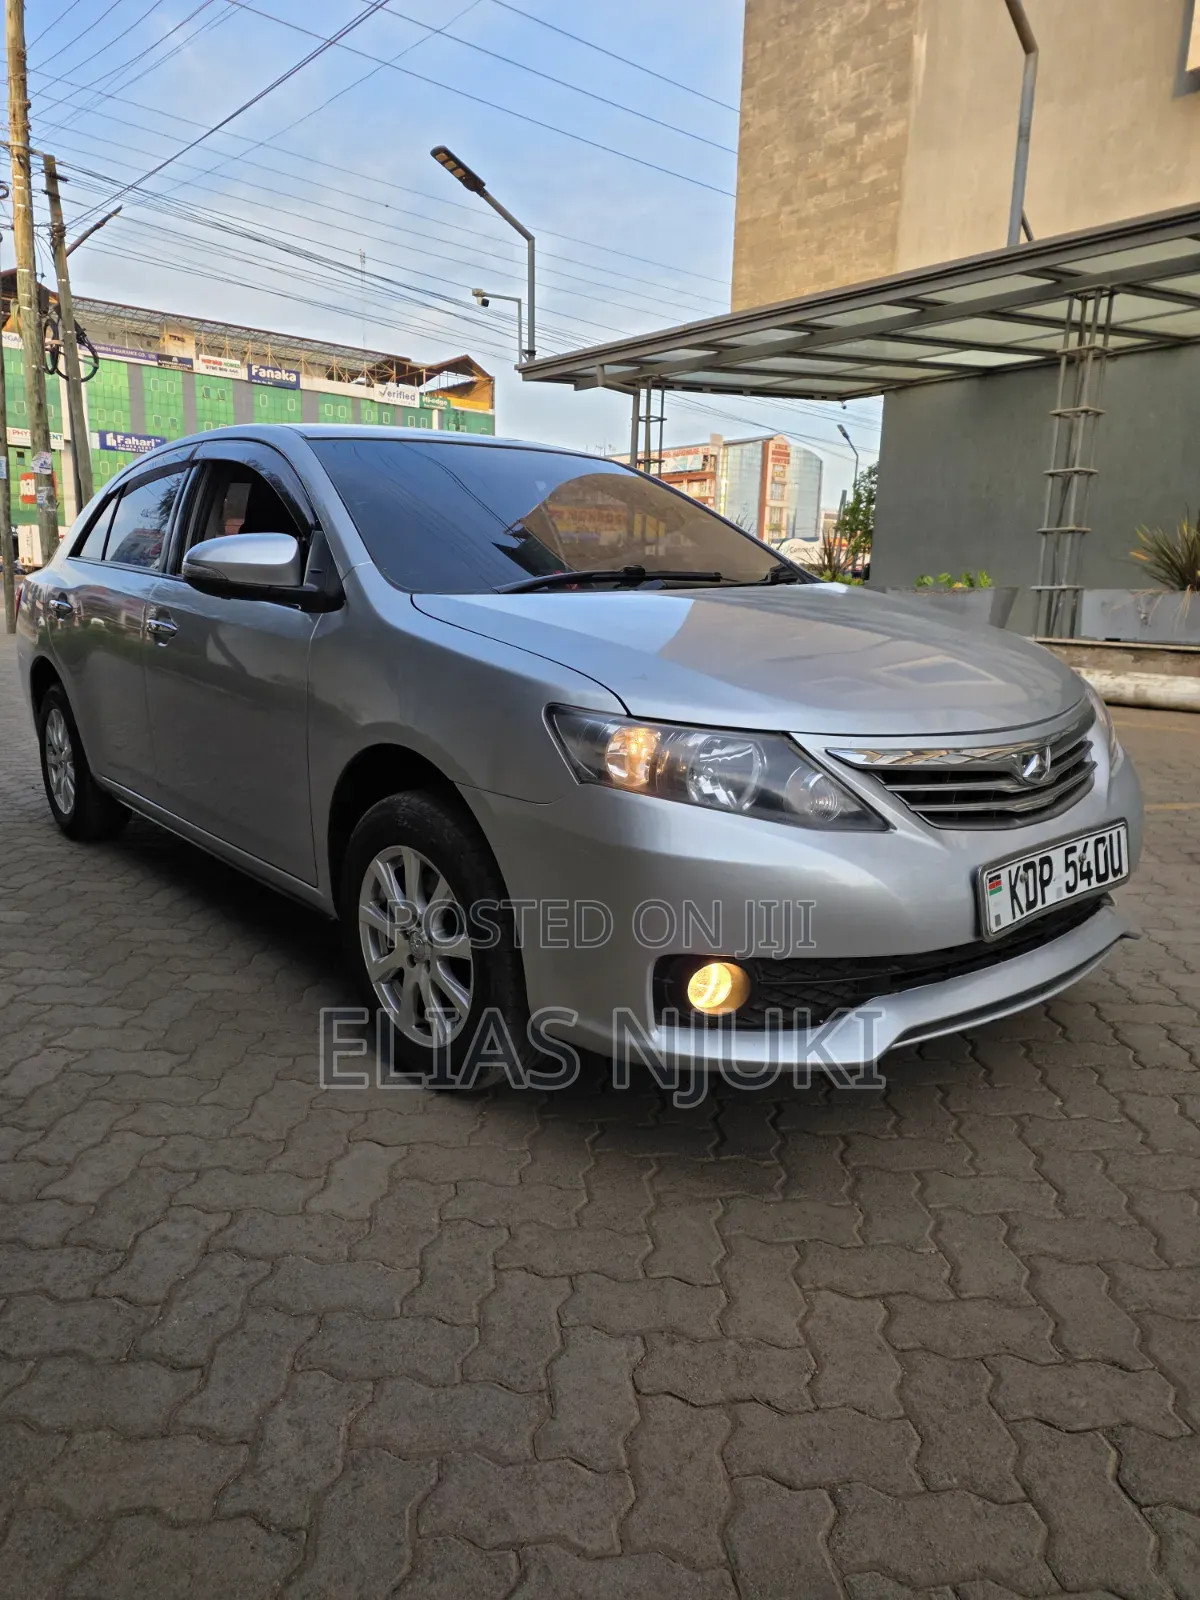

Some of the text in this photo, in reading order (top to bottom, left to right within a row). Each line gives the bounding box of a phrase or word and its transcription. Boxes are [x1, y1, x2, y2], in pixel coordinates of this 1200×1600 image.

[251, 364, 297, 382] Fanaka
[116, 434, 155, 447] Fahari
[1008, 830, 1123, 920] KDP 540U
